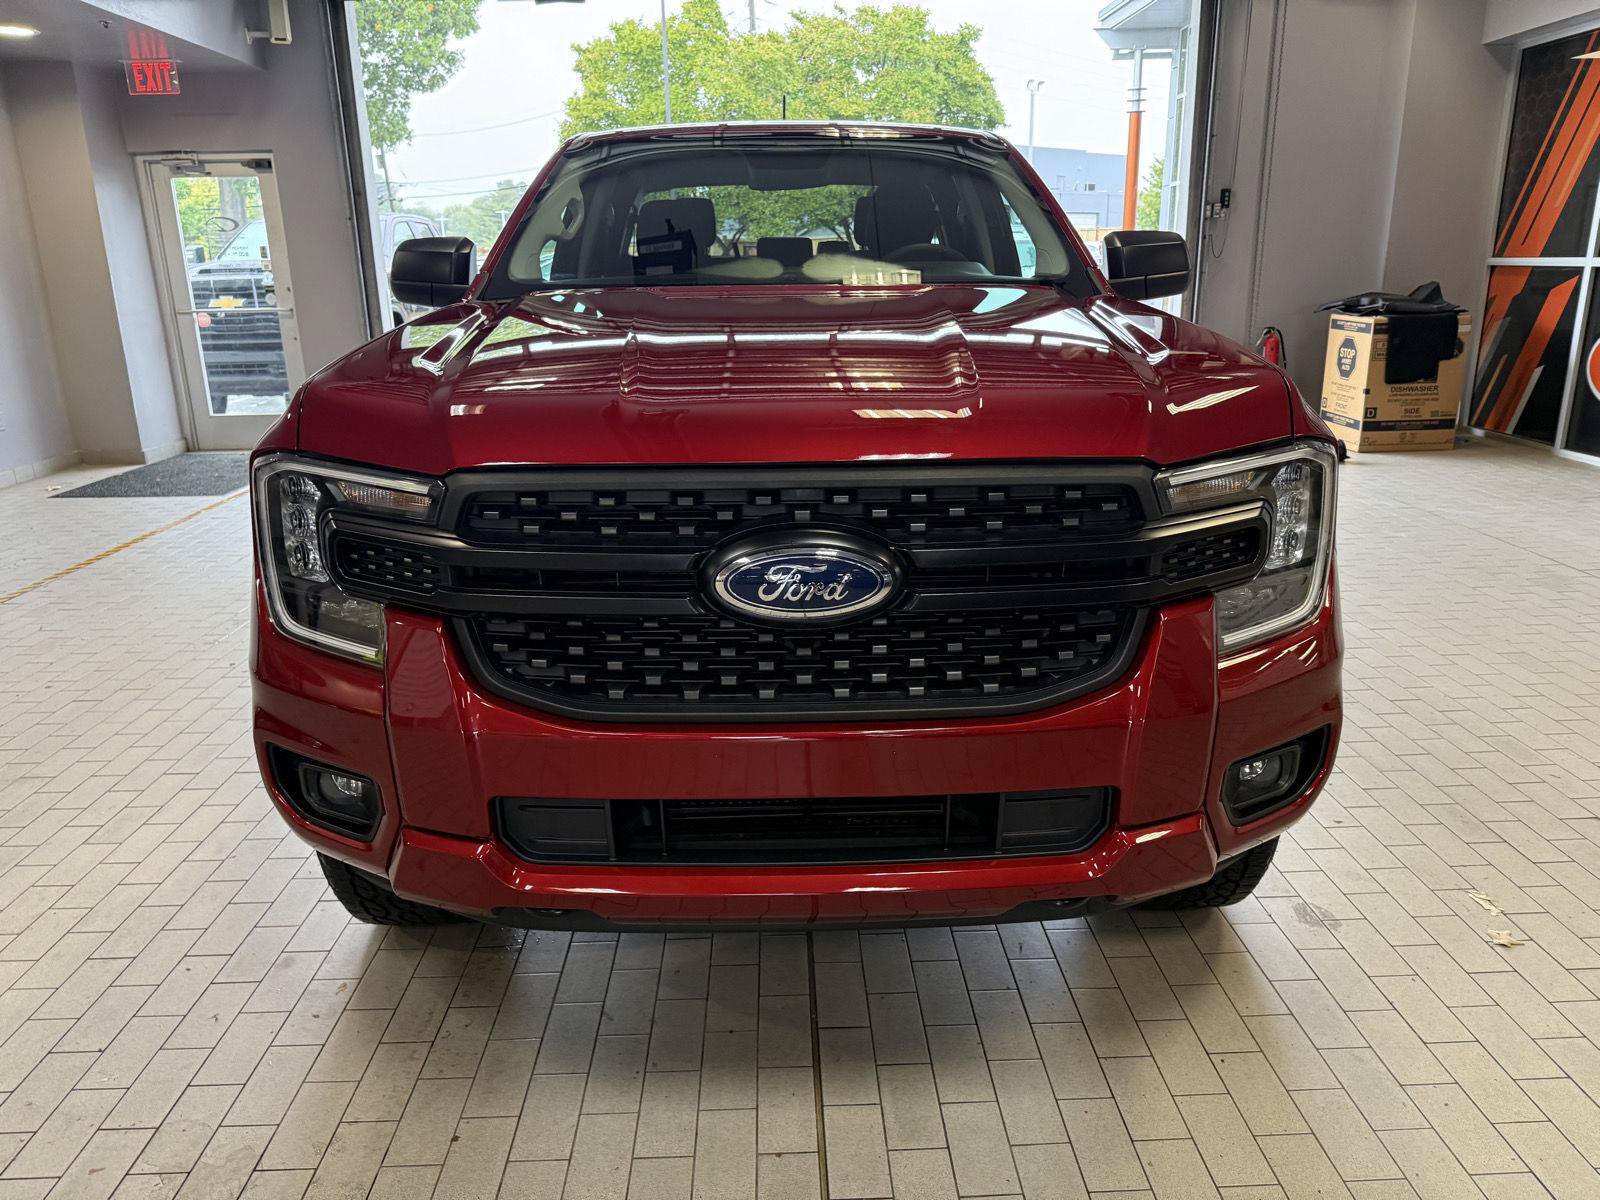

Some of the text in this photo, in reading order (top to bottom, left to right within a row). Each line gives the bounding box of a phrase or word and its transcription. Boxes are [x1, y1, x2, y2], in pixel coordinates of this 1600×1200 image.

[132, 63, 171, 91] EXIT
[1340, 348, 1355, 358] STOP
[1391, 385, 1439, 393] DISHWASHER
[1367, 408, 1375, 418] D
[758, 563, 852, 601] Ford
